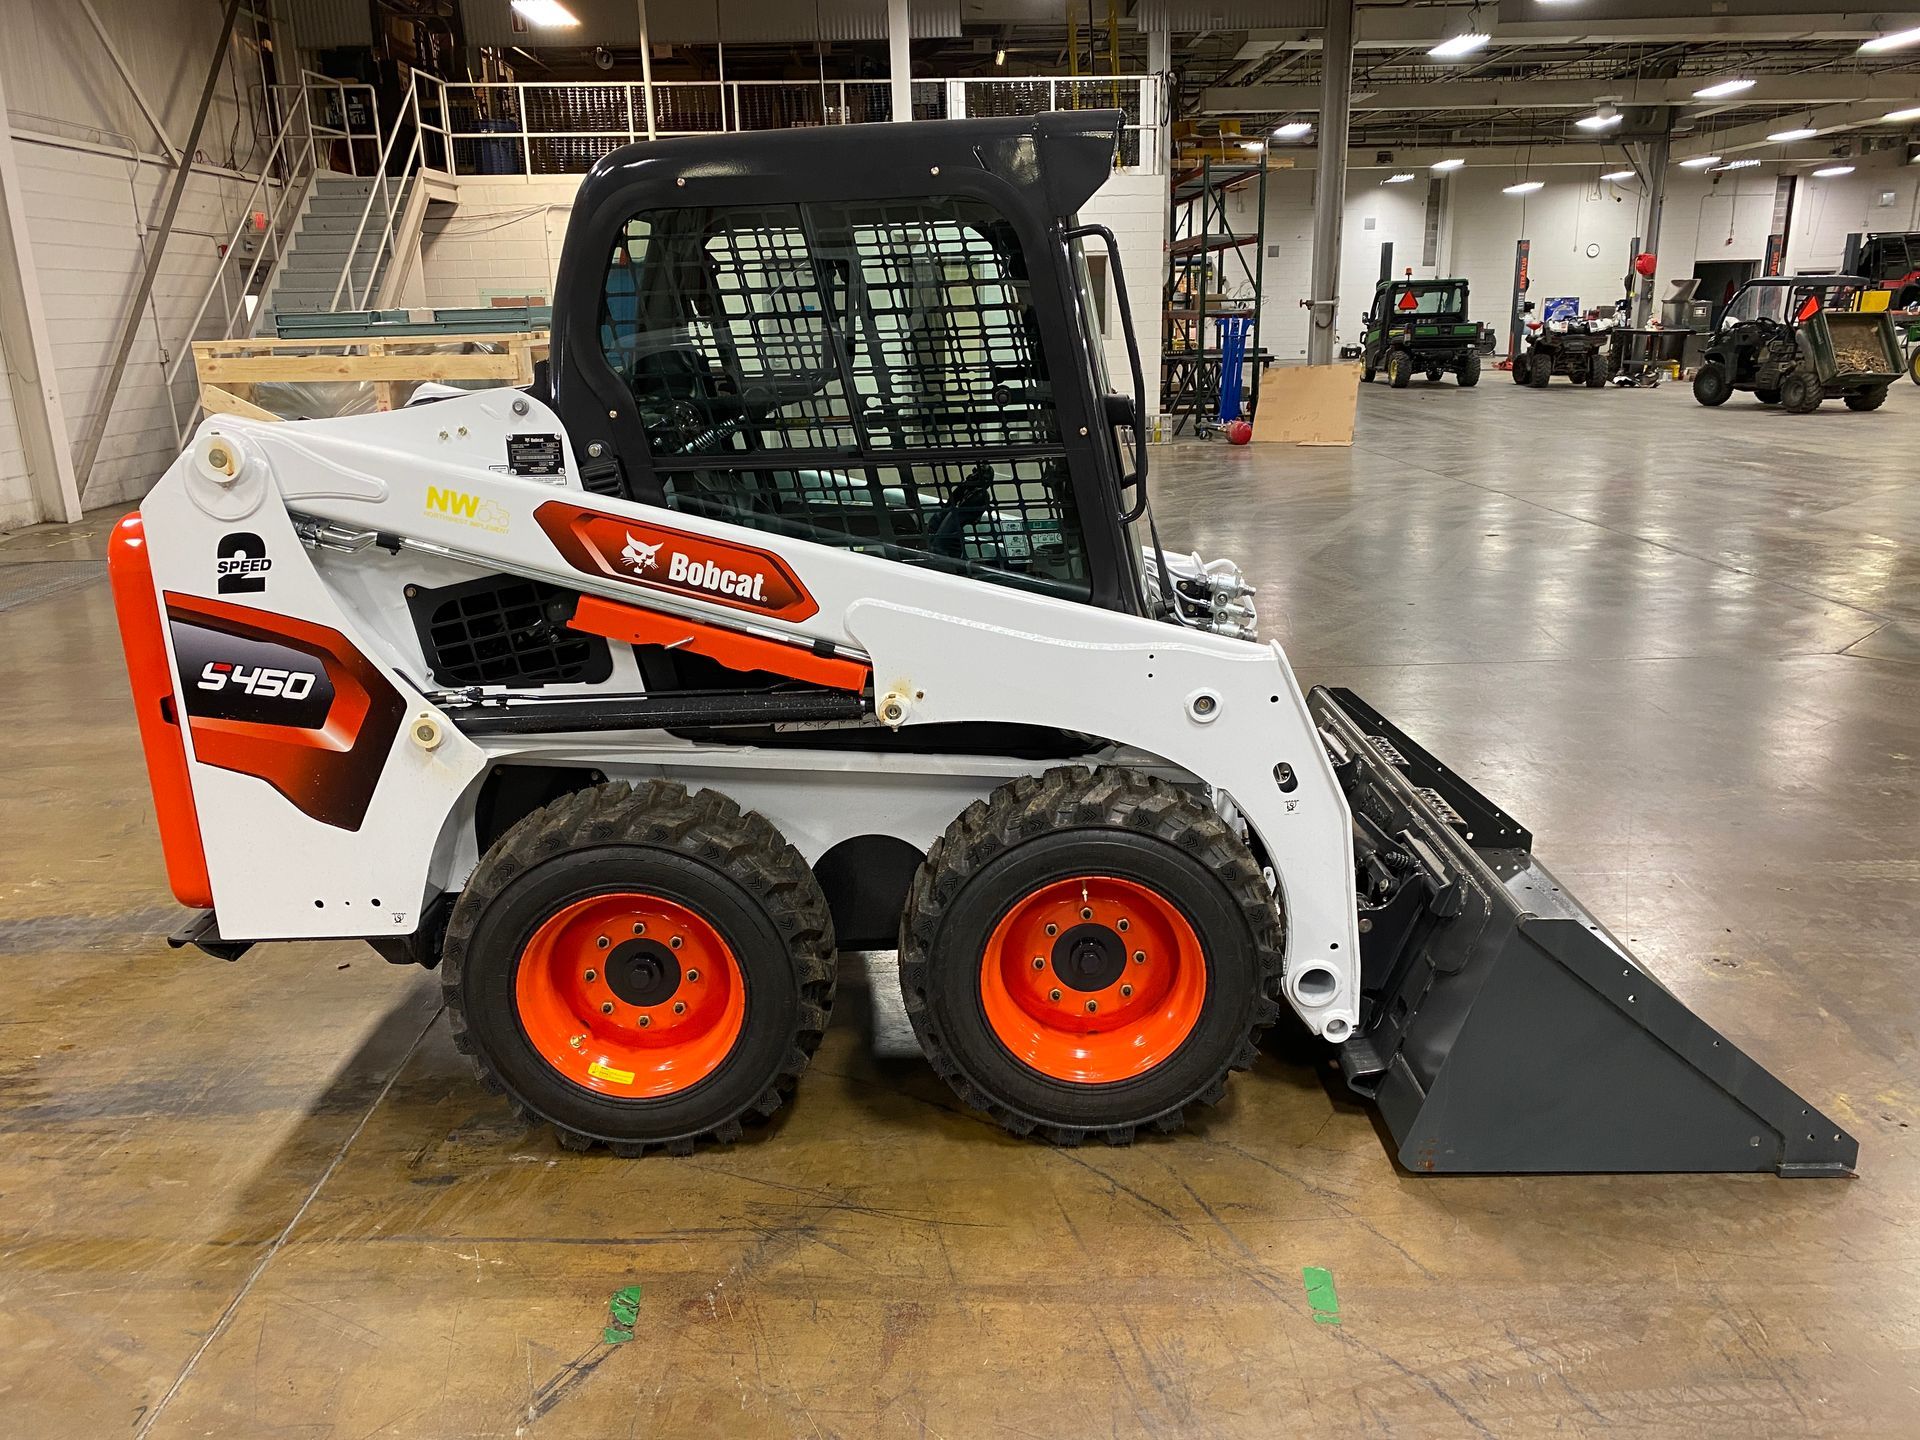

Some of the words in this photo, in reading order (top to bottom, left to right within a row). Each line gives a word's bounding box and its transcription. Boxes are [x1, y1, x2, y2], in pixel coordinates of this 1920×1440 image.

[426, 486, 480, 518] NW
[217, 532, 266, 594] 2
[217, 559, 272, 573] SPEED
[668, 551, 765, 601] Bobcat
[197, 662, 316, 700] S450
